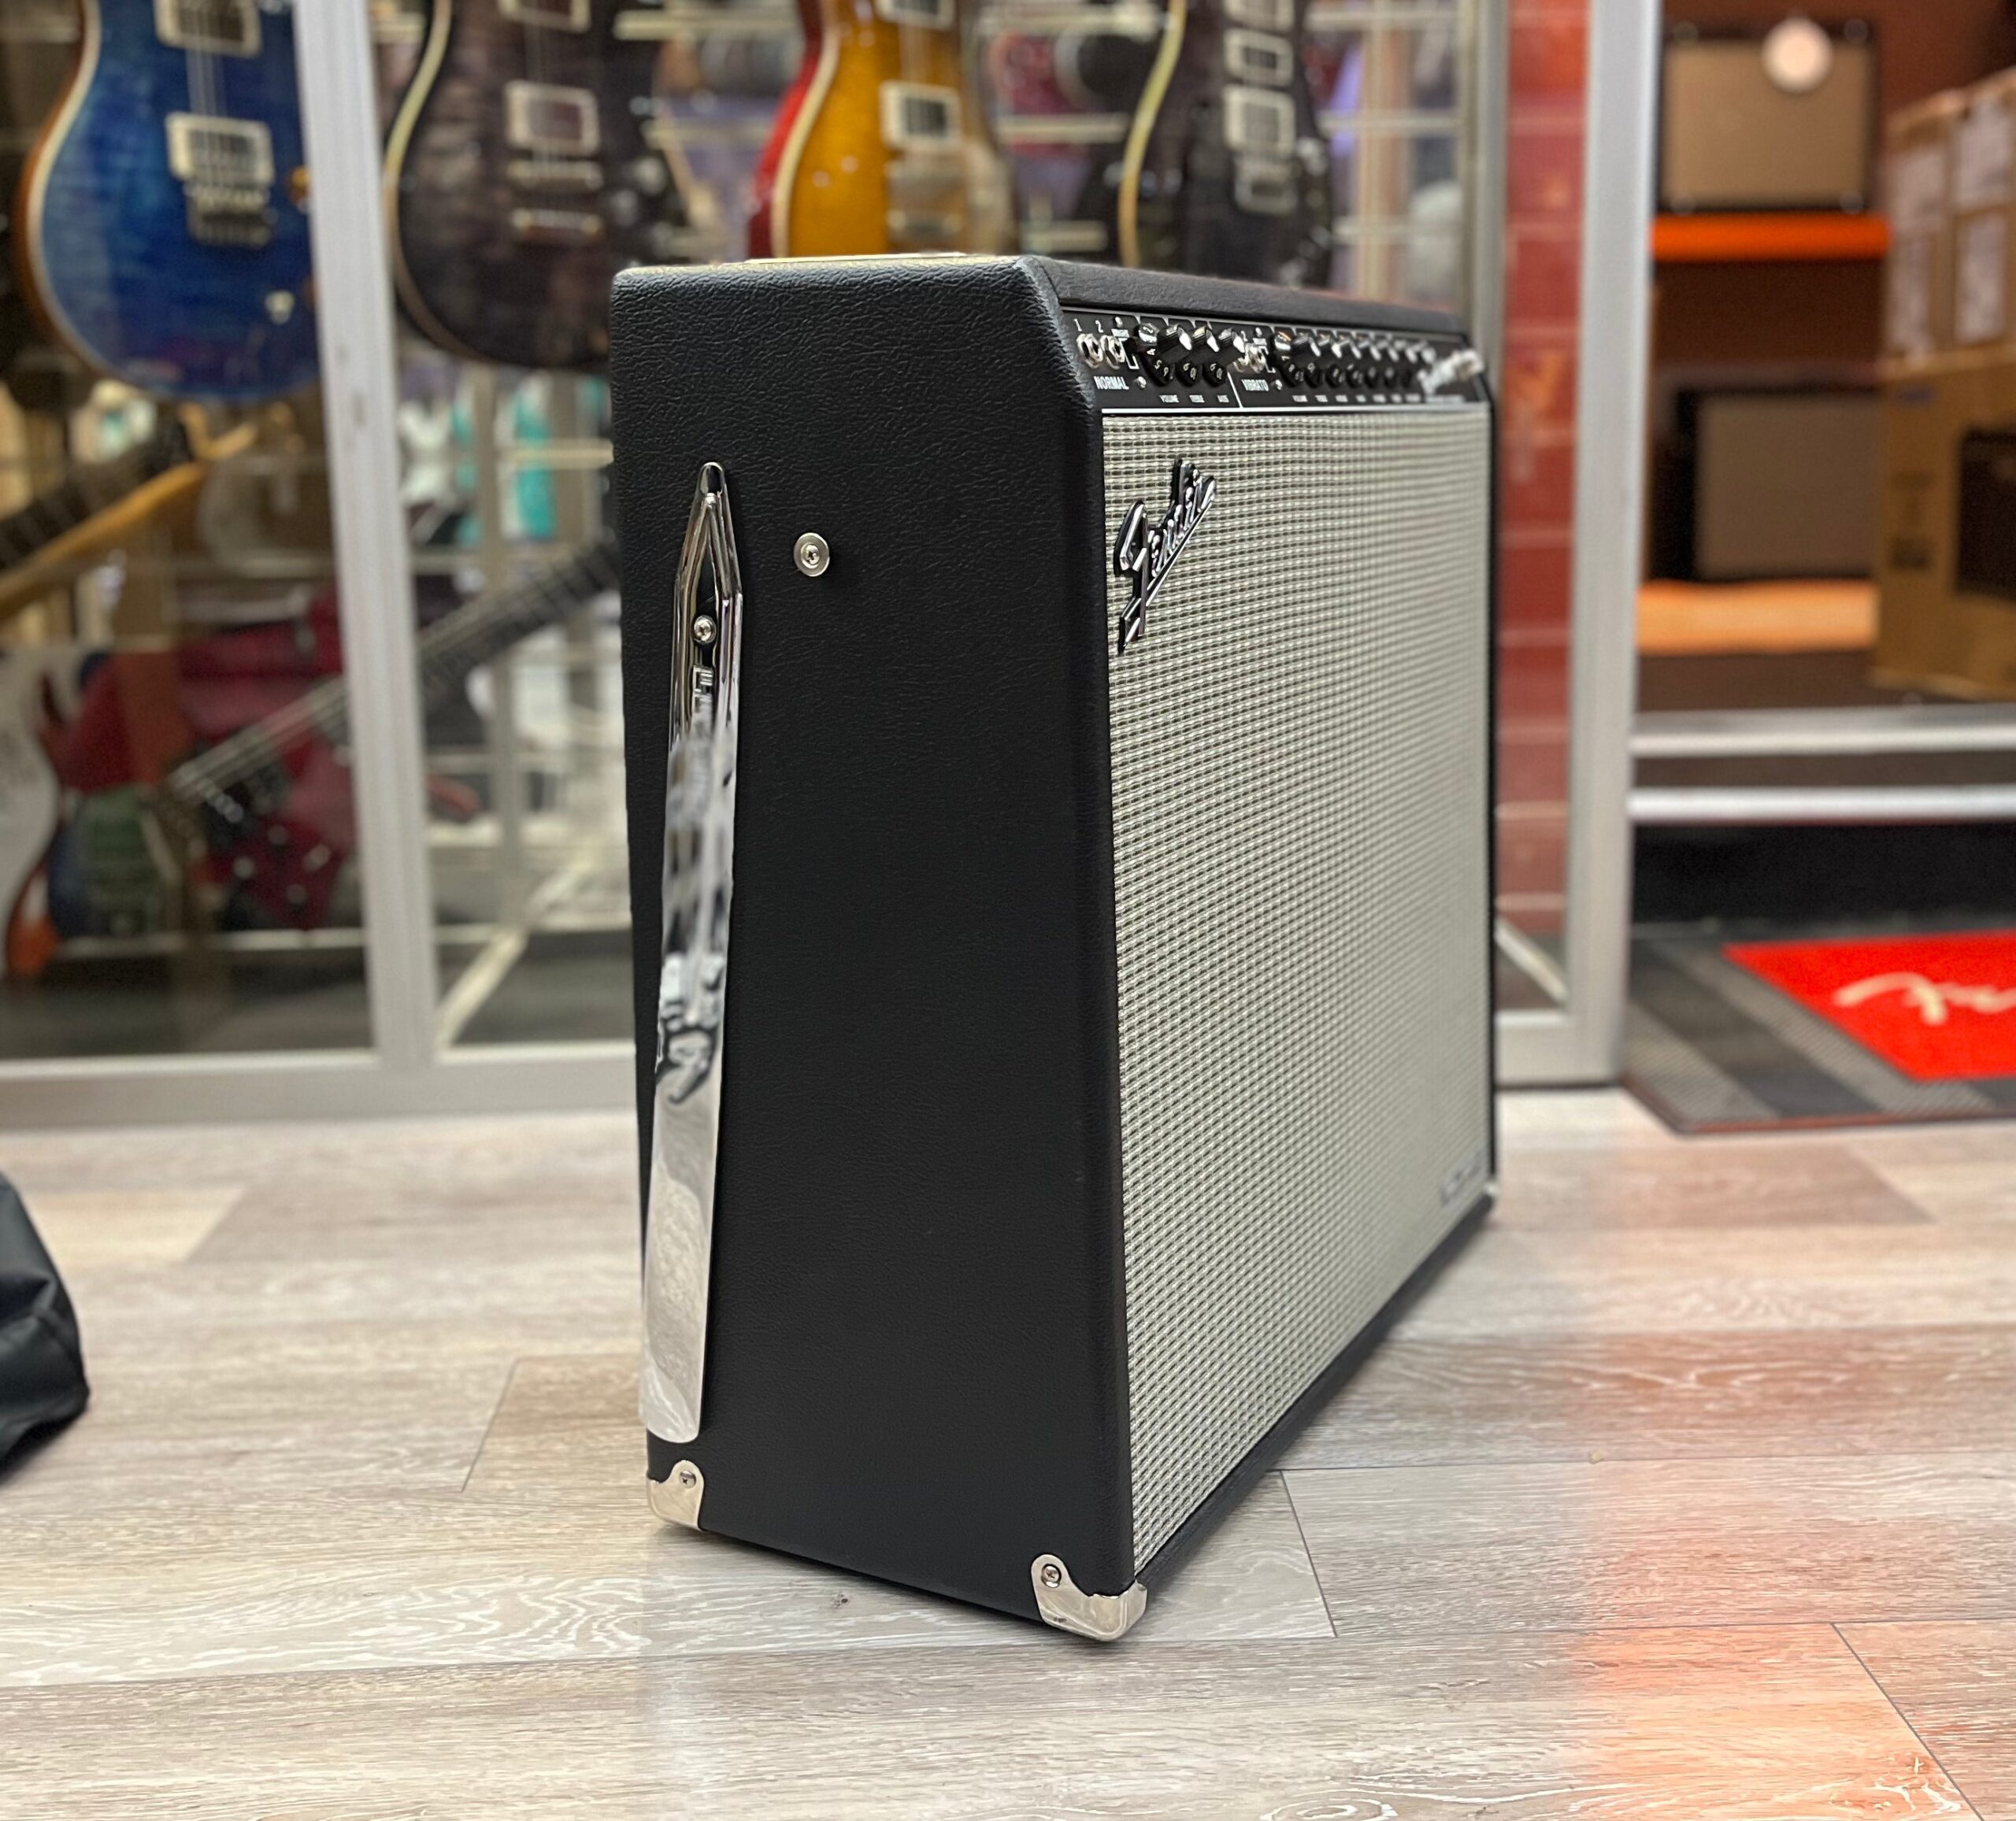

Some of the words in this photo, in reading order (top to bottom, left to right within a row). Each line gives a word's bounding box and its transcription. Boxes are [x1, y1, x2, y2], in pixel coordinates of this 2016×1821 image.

[1073, 318, 1083, 331] 1
[1095, 320, 1104, 333] 2
[1093, 376, 1129, 390] NORMAL
[1114, 460, 1215, 652] Fender
